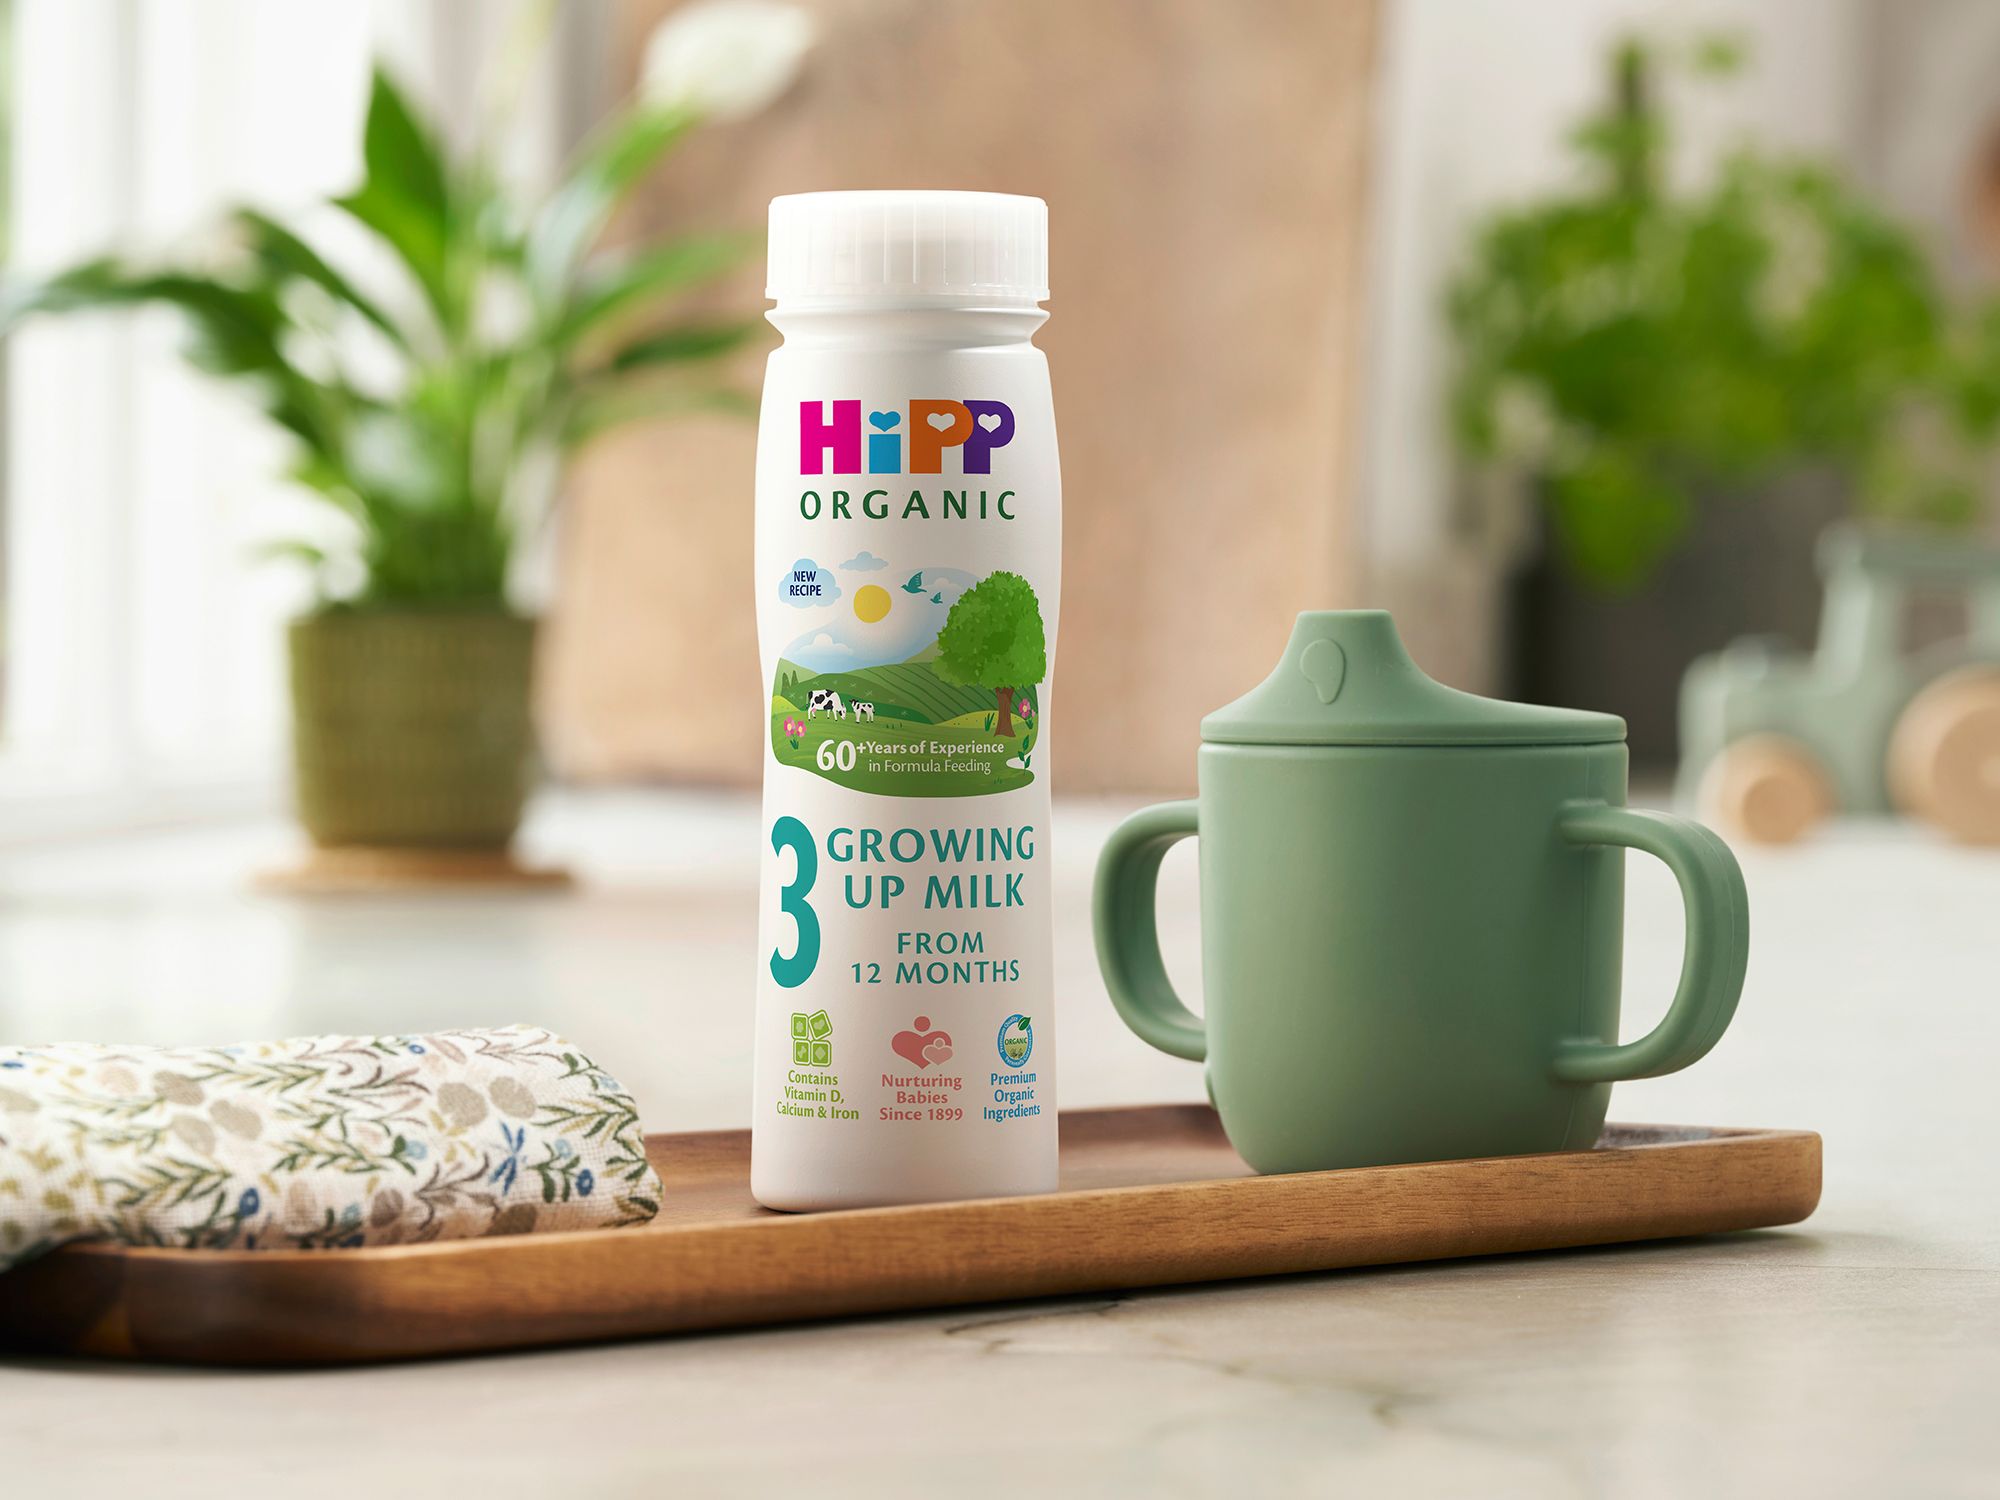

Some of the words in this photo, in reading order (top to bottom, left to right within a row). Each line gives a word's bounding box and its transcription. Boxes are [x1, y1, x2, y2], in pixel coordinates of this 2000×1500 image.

[800, 399, 1015, 475] HiPP
[800, 490, 1016, 520] ORGANIC
[793, 571, 817, 583] NEW
[789, 584, 822, 597] RECIPE
[909, 740, 926, 754] of
[930, 740, 1005, 757] Experience
[868, 759, 881, 772] in
[884, 759, 941, 773] Formula
[944, 759, 992, 775] Feeding
[826, 825, 1035, 863] GROWING
[844, 875, 905, 909] UP
[924, 873, 1025, 909] MILK
[770, 816, 821, 988] 3
[897, 931, 985, 954] FROM
[851, 962, 882, 984] 12
[895, 959, 1020, 984] MONTHS
[1004, 1037, 1028, 1046] ORGANIC
[788, 1070, 838, 1086] Contains
[881, 1074, 962, 1091] Nurturing
[990, 1071, 1037, 1086] Premium
[784, 1086, 827, 1102] Vitamin
[830, 1089, 845, 1104] D,
[896, 1091, 948, 1104] Babies
[994, 1087, 1035, 1105] Organic
[776, 1101, 814, 1118] Calcium
[817, 1106, 828, 1119] &
[830, 1106, 860, 1120] Iron
[879, 1107, 922, 1121] Since
[928, 1107, 963, 1121] 1899
[983, 1104, 1041, 1123] Ingredients
